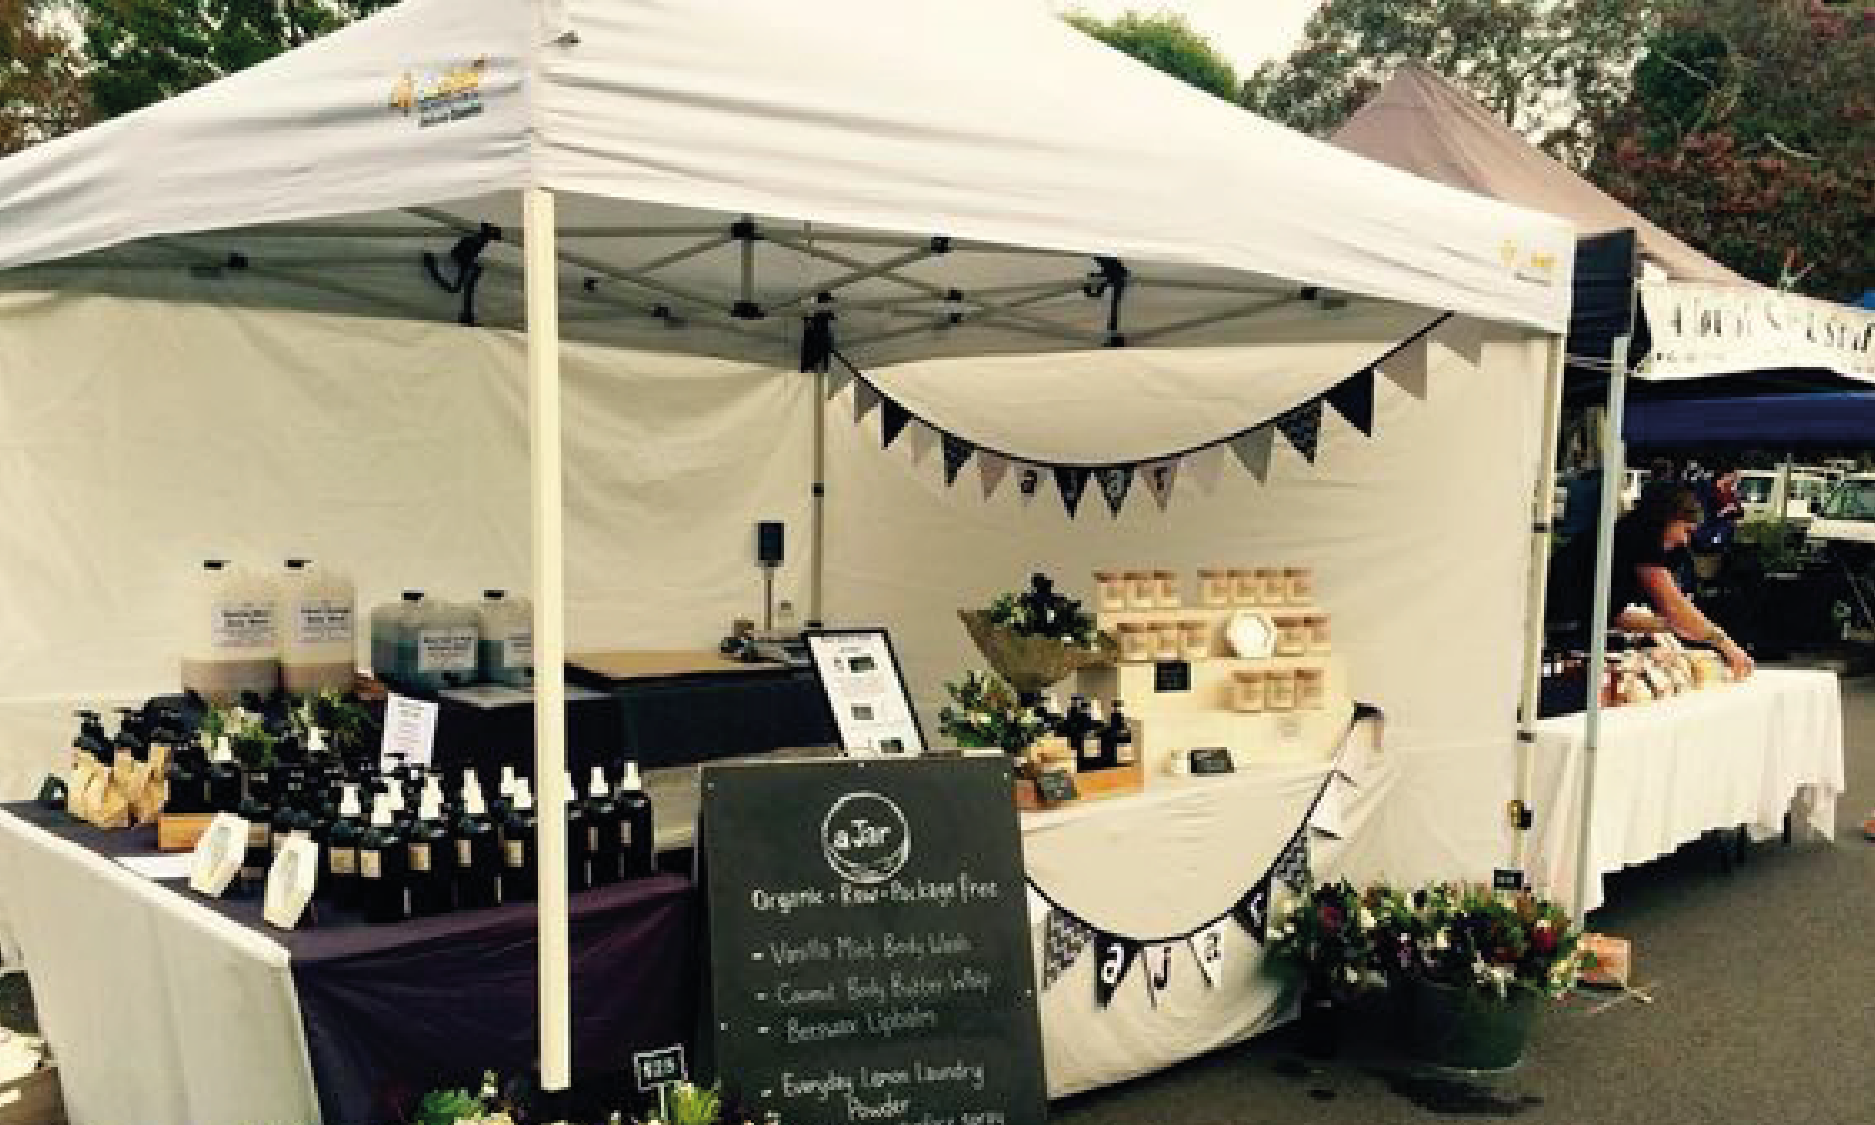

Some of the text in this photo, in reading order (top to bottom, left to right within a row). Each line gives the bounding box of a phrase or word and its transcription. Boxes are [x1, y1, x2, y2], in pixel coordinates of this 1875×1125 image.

[751, 888, 823, 914] Organic
[840, 882, 878, 906] Raw
[890, 880, 955, 907] Package
[769, 937, 831, 965] Vanilla
[835, 935, 876, 960] Mint
[883, 932, 925, 960] Body
[847, 976, 885, 1004] Body
[890, 972, 943, 998] Butter
[782, 1059, 984, 1102] Everyday Lemon Laundry
[847, 1092, 909, 1120] Powder
